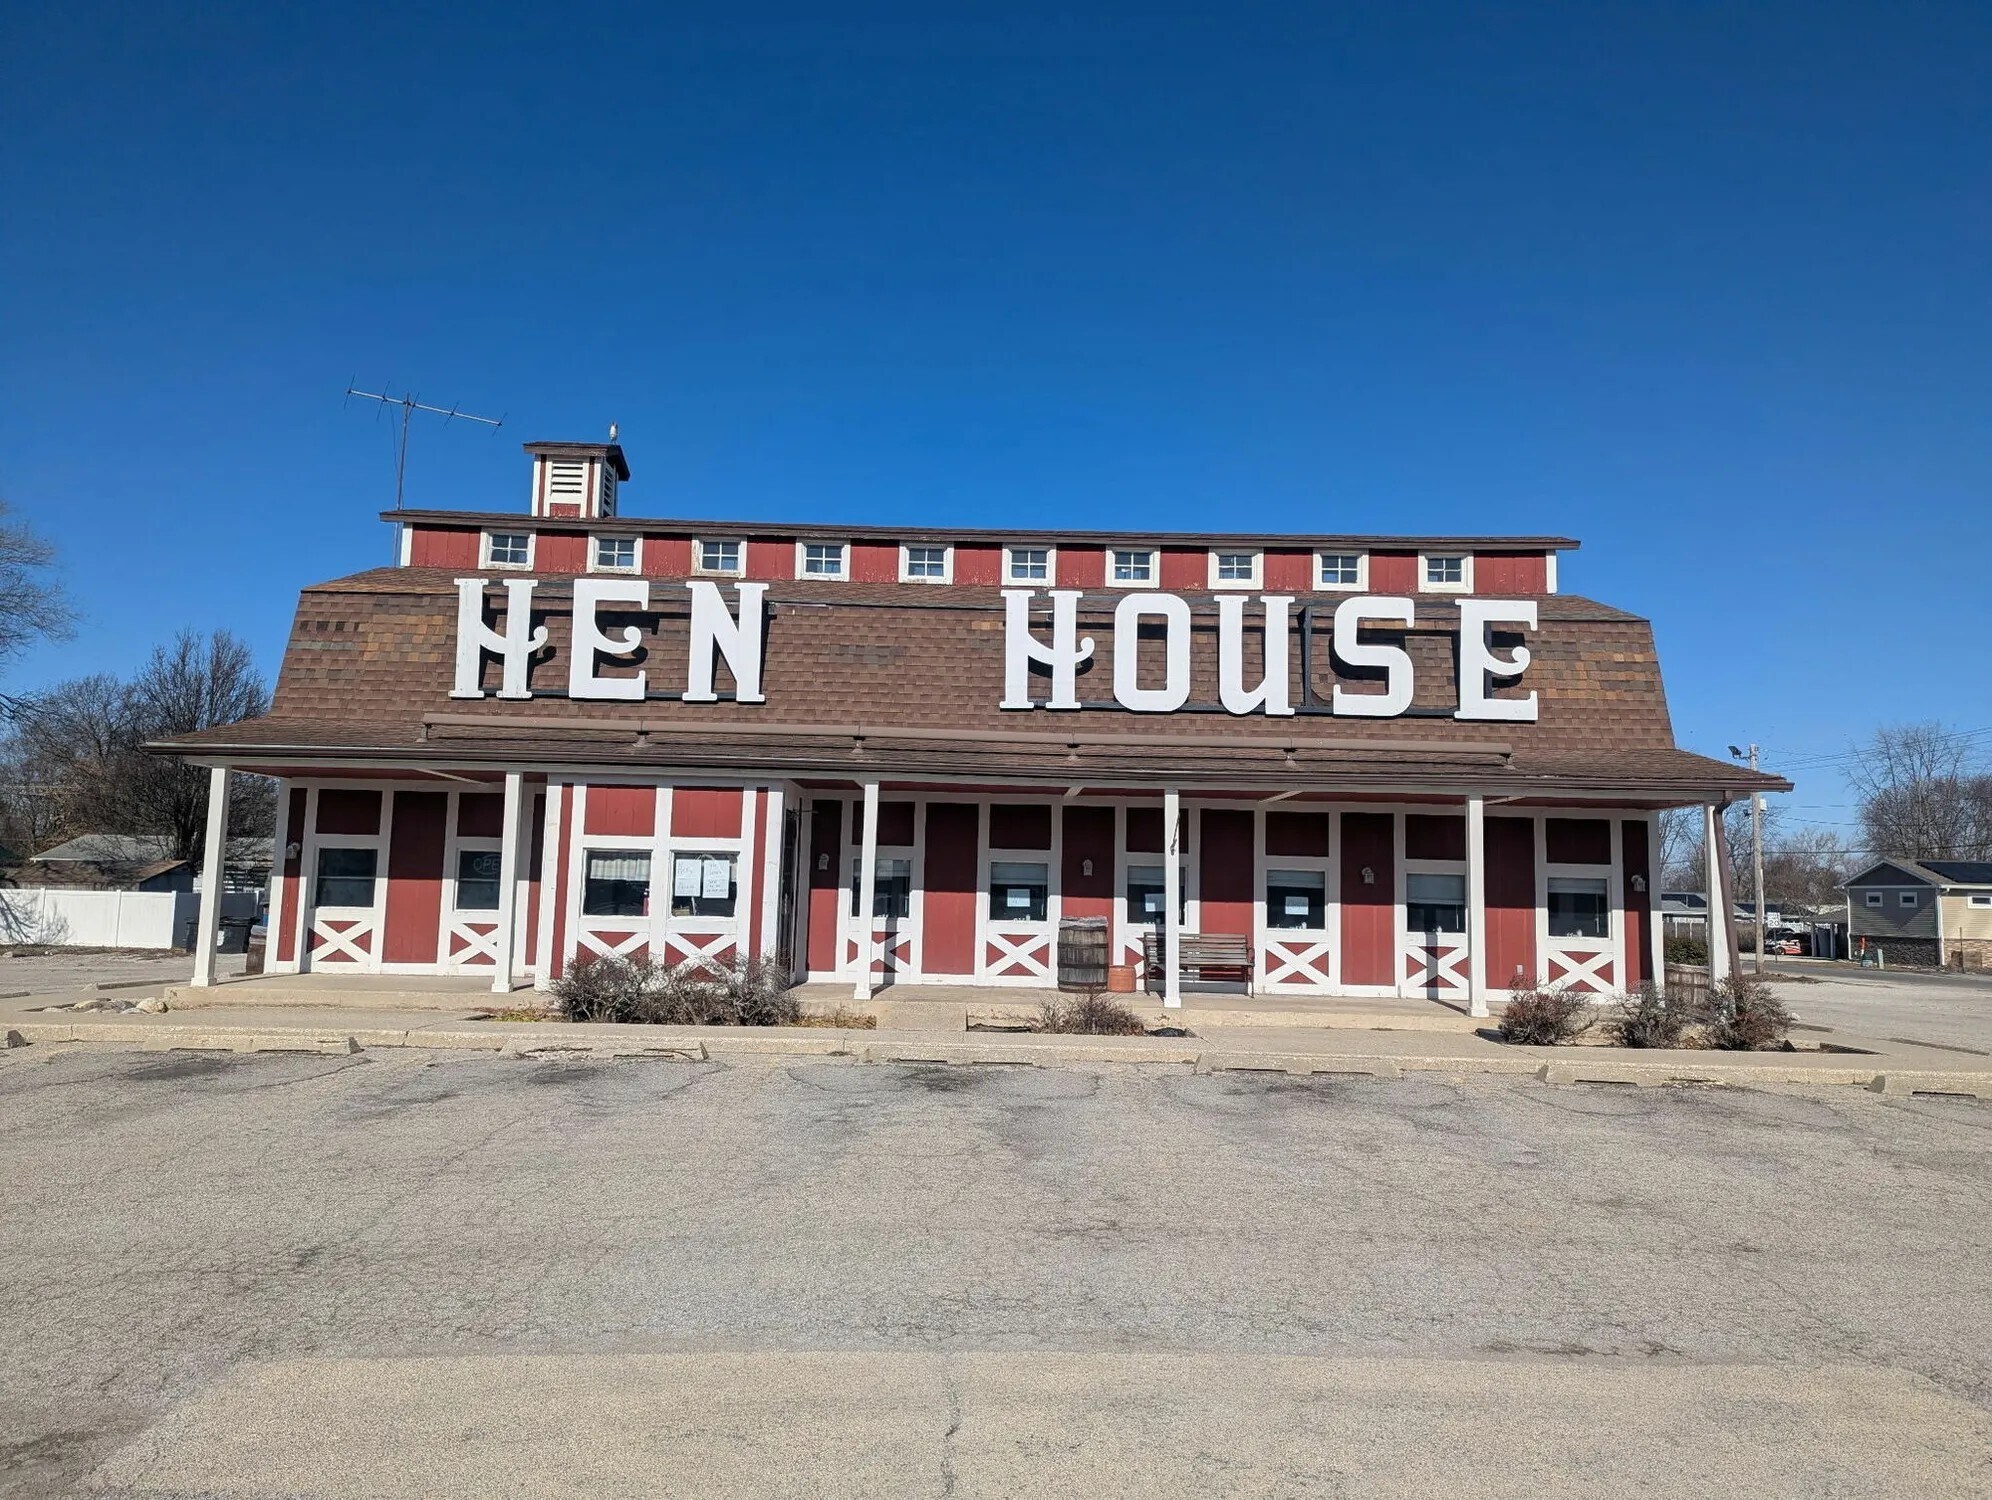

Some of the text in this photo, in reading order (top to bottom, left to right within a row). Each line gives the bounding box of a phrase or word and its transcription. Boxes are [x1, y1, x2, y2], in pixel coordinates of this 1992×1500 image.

[448, 578, 1538, 721] HEN HOUSE
[473, 857, 501, 872] OPE
